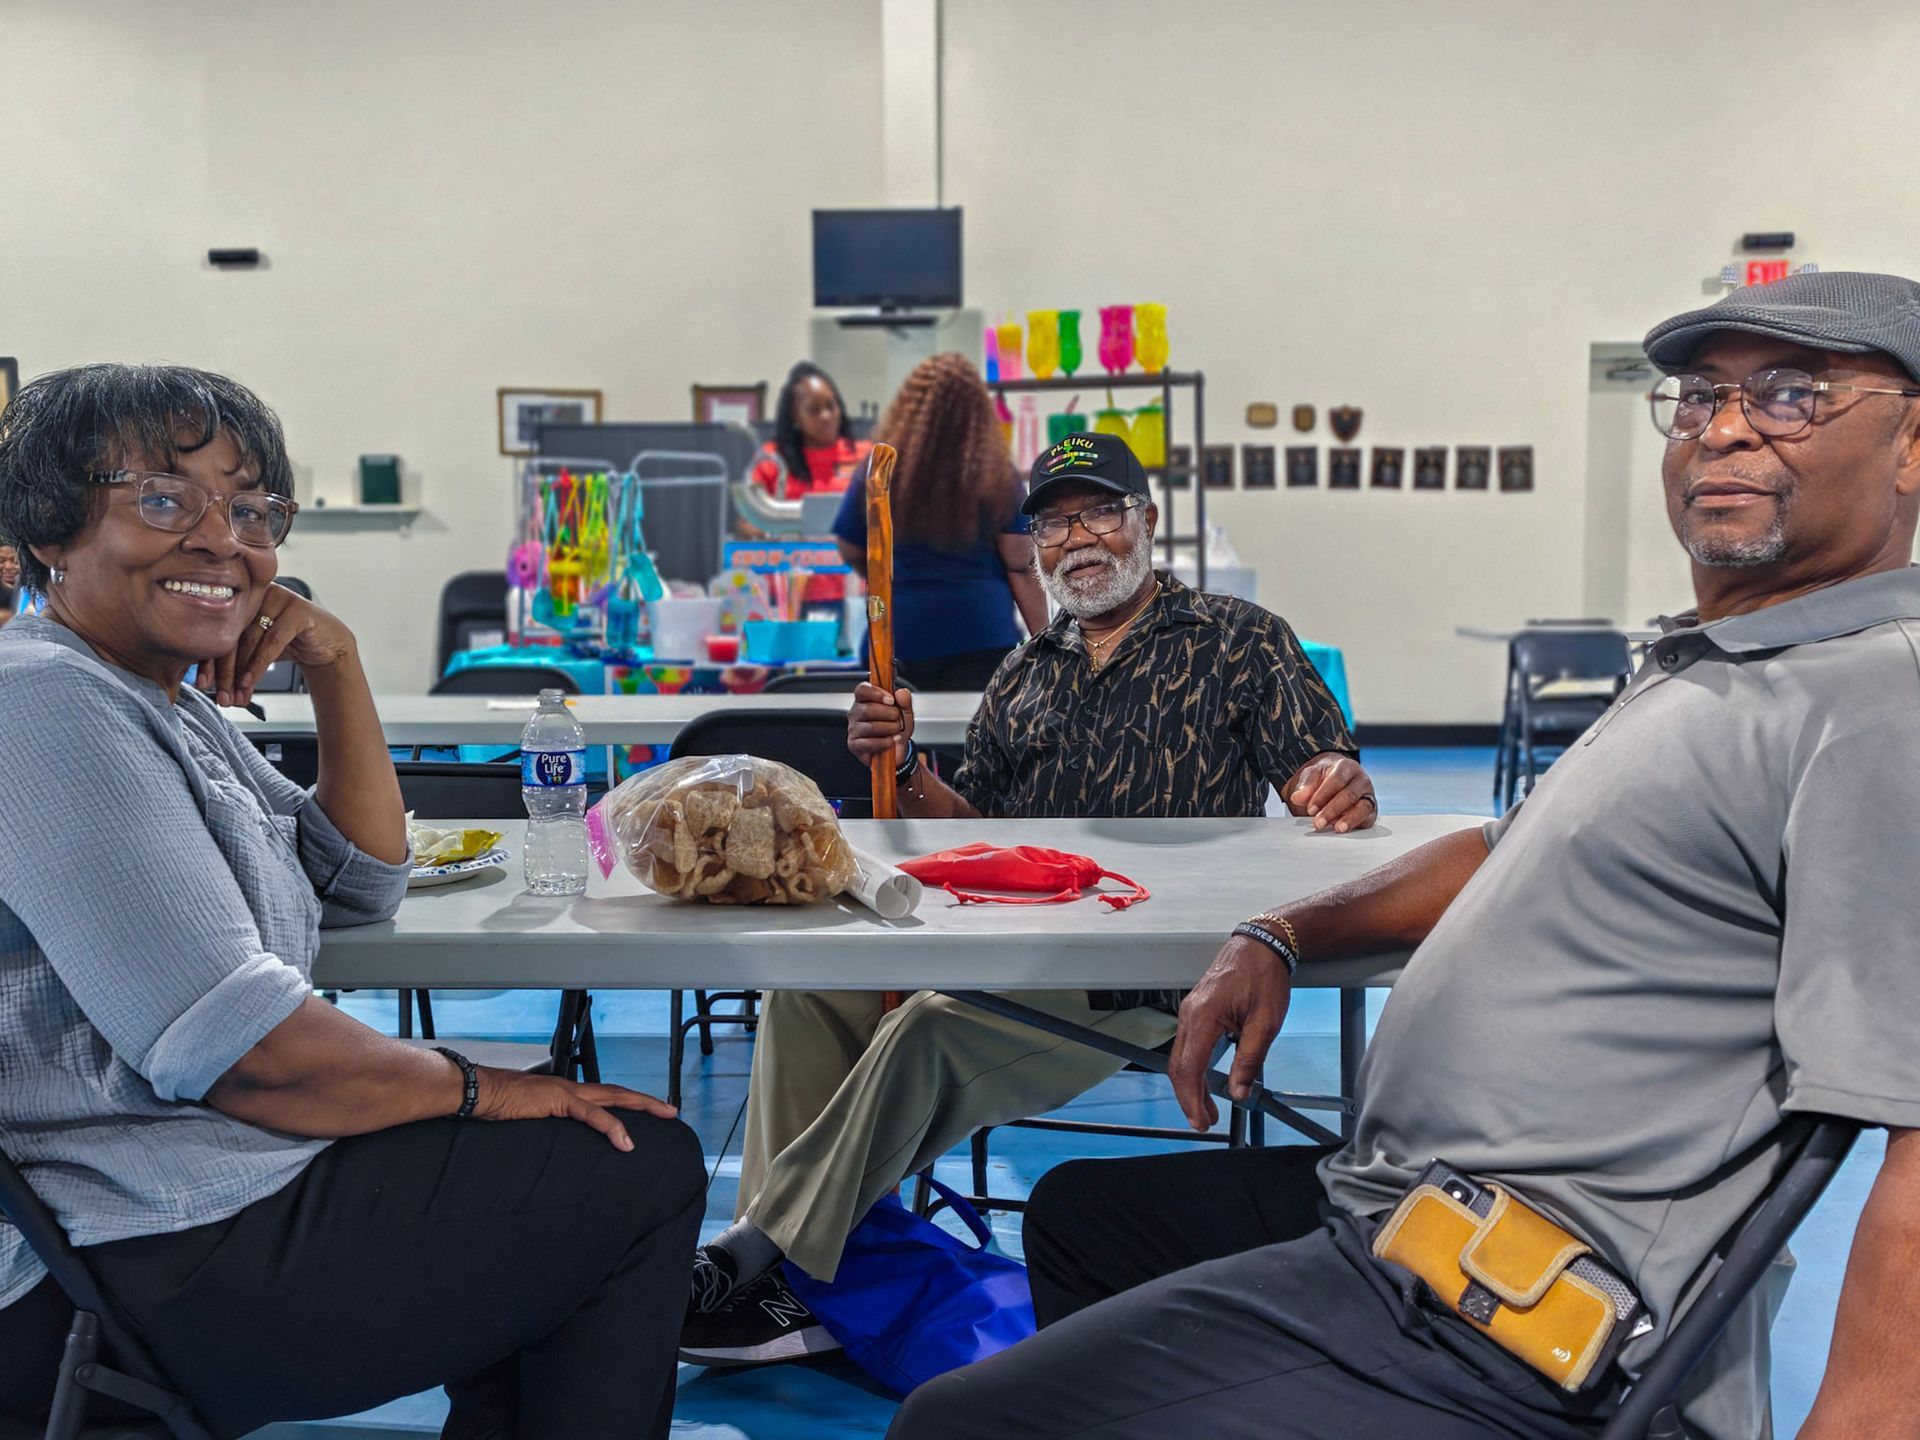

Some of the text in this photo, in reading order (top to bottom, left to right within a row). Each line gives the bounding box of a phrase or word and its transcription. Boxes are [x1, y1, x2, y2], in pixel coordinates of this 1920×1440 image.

[1745, 260, 1789, 288] EXIT
[1050, 437, 1094, 456] PLEIKU
[541, 753, 567, 764] Pure
[544, 763, 565, 776] Life
[1249, 925, 1274, 943] LIVES
